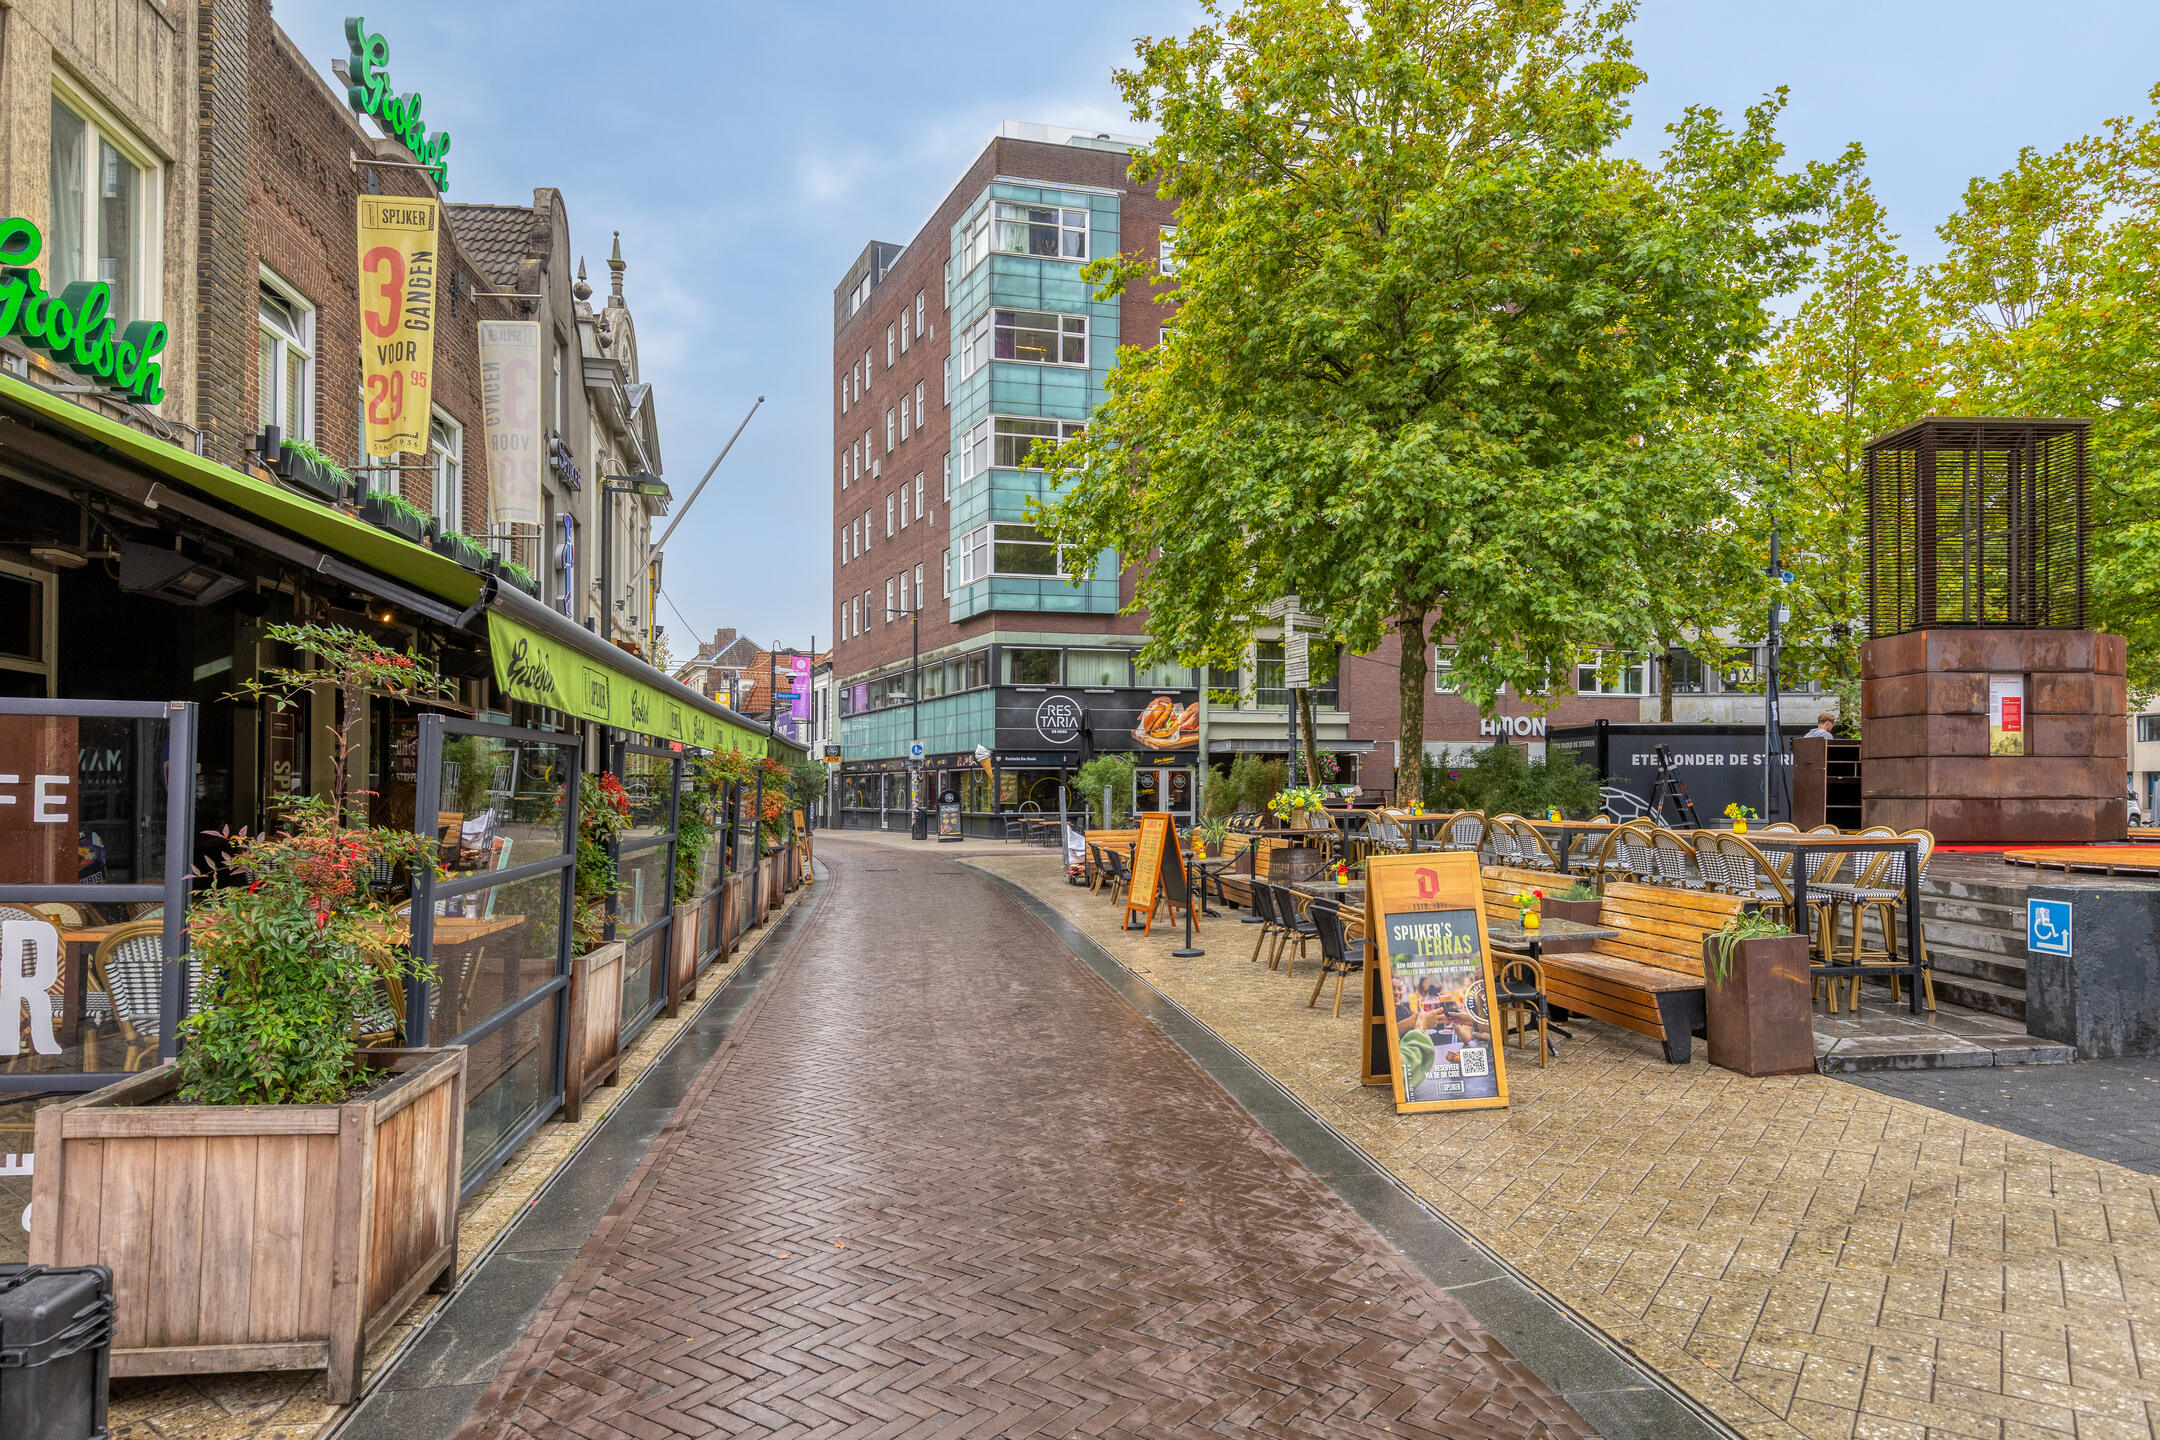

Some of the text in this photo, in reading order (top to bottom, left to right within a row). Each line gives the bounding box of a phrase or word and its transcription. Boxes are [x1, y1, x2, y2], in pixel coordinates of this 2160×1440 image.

[347, 17, 450, 192] Grolsch
[382, 208, 426, 226] SPIJKER
[363, 246, 405, 338] 3
[404, 251, 432, 331] GANGEN
[0, 217, 167, 405] Grolsch
[377, 341, 416, 366] VOOR
[410, 370, 427, 388] 95
[1047, 704, 1072, 716] RES
[1040, 716, 1079, 728] TARIA
[1674, 754, 1724, 766] ONDER
[1729, 754, 1748, 766] DE
[1393, 922, 1453, 941] SPIJKER'S
[1415, 935, 1473, 957] TERRAS
